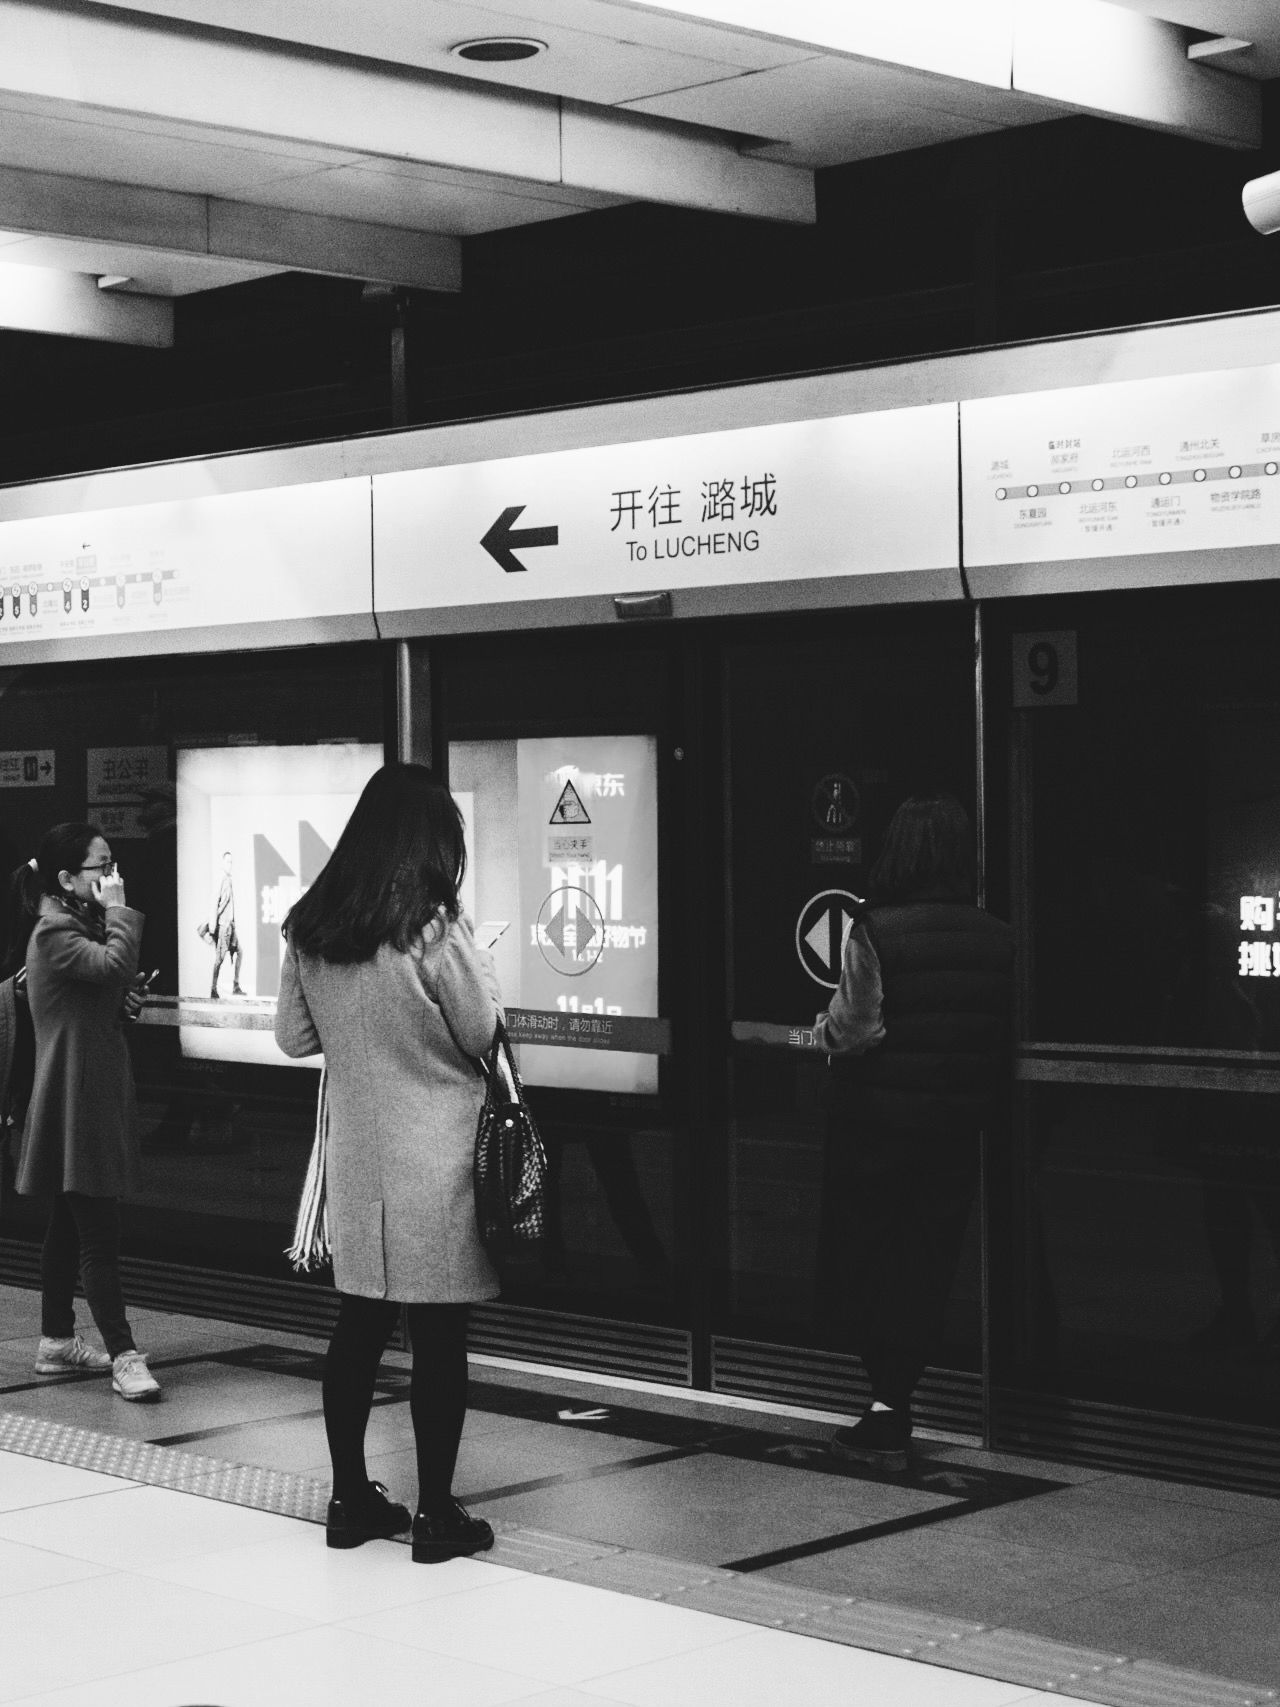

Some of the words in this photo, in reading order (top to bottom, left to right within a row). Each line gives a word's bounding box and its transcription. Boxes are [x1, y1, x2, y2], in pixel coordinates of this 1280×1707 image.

[610, 484, 683, 532] 开往
[700, 472, 778, 523] 潞城
[626, 541, 648, 562] To
[654, 529, 761, 560] LUCHENG
[1027, 641, 1059, 696] 9
[1240, 890, 1280, 931] 购
